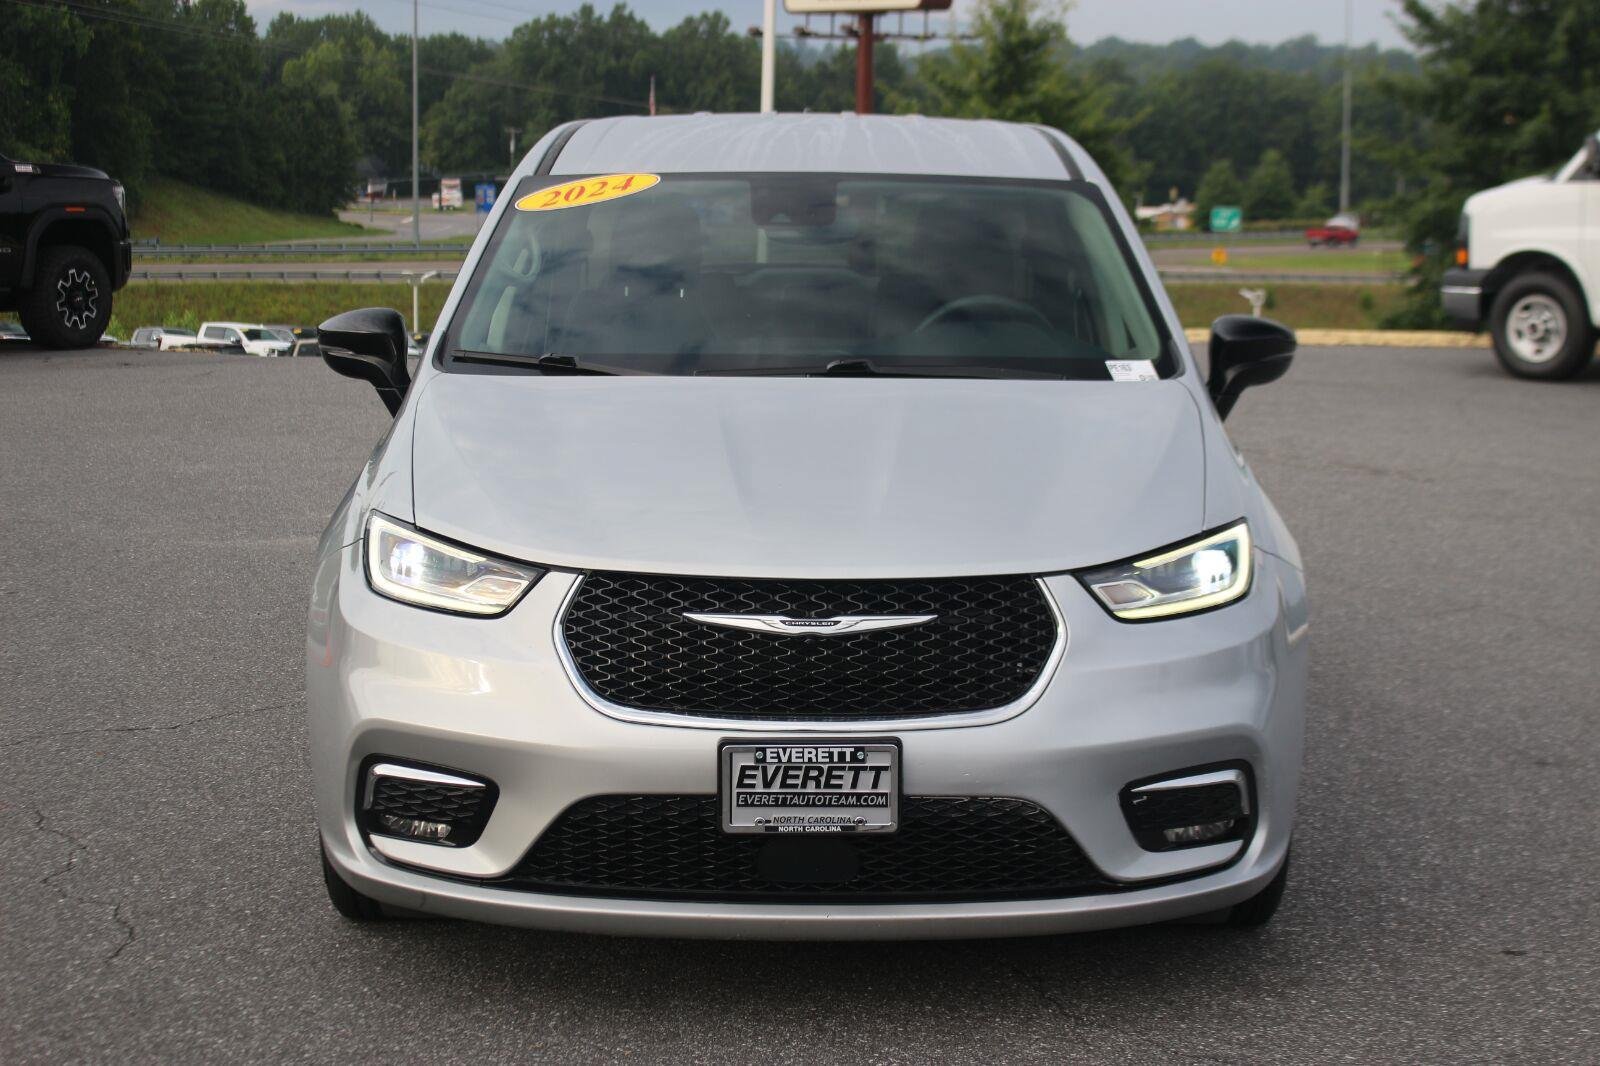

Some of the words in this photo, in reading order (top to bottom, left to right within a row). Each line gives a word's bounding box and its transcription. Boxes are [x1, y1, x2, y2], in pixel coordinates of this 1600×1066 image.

[541, 176, 635, 208] 2024
[766, 748, 854, 763] EVERETT
[736, 765, 889, 789] EVERETT
[738, 795, 886, 805] EVERETTAUTOTEAM.COM
[807, 816, 852, 824] CAROLINA
